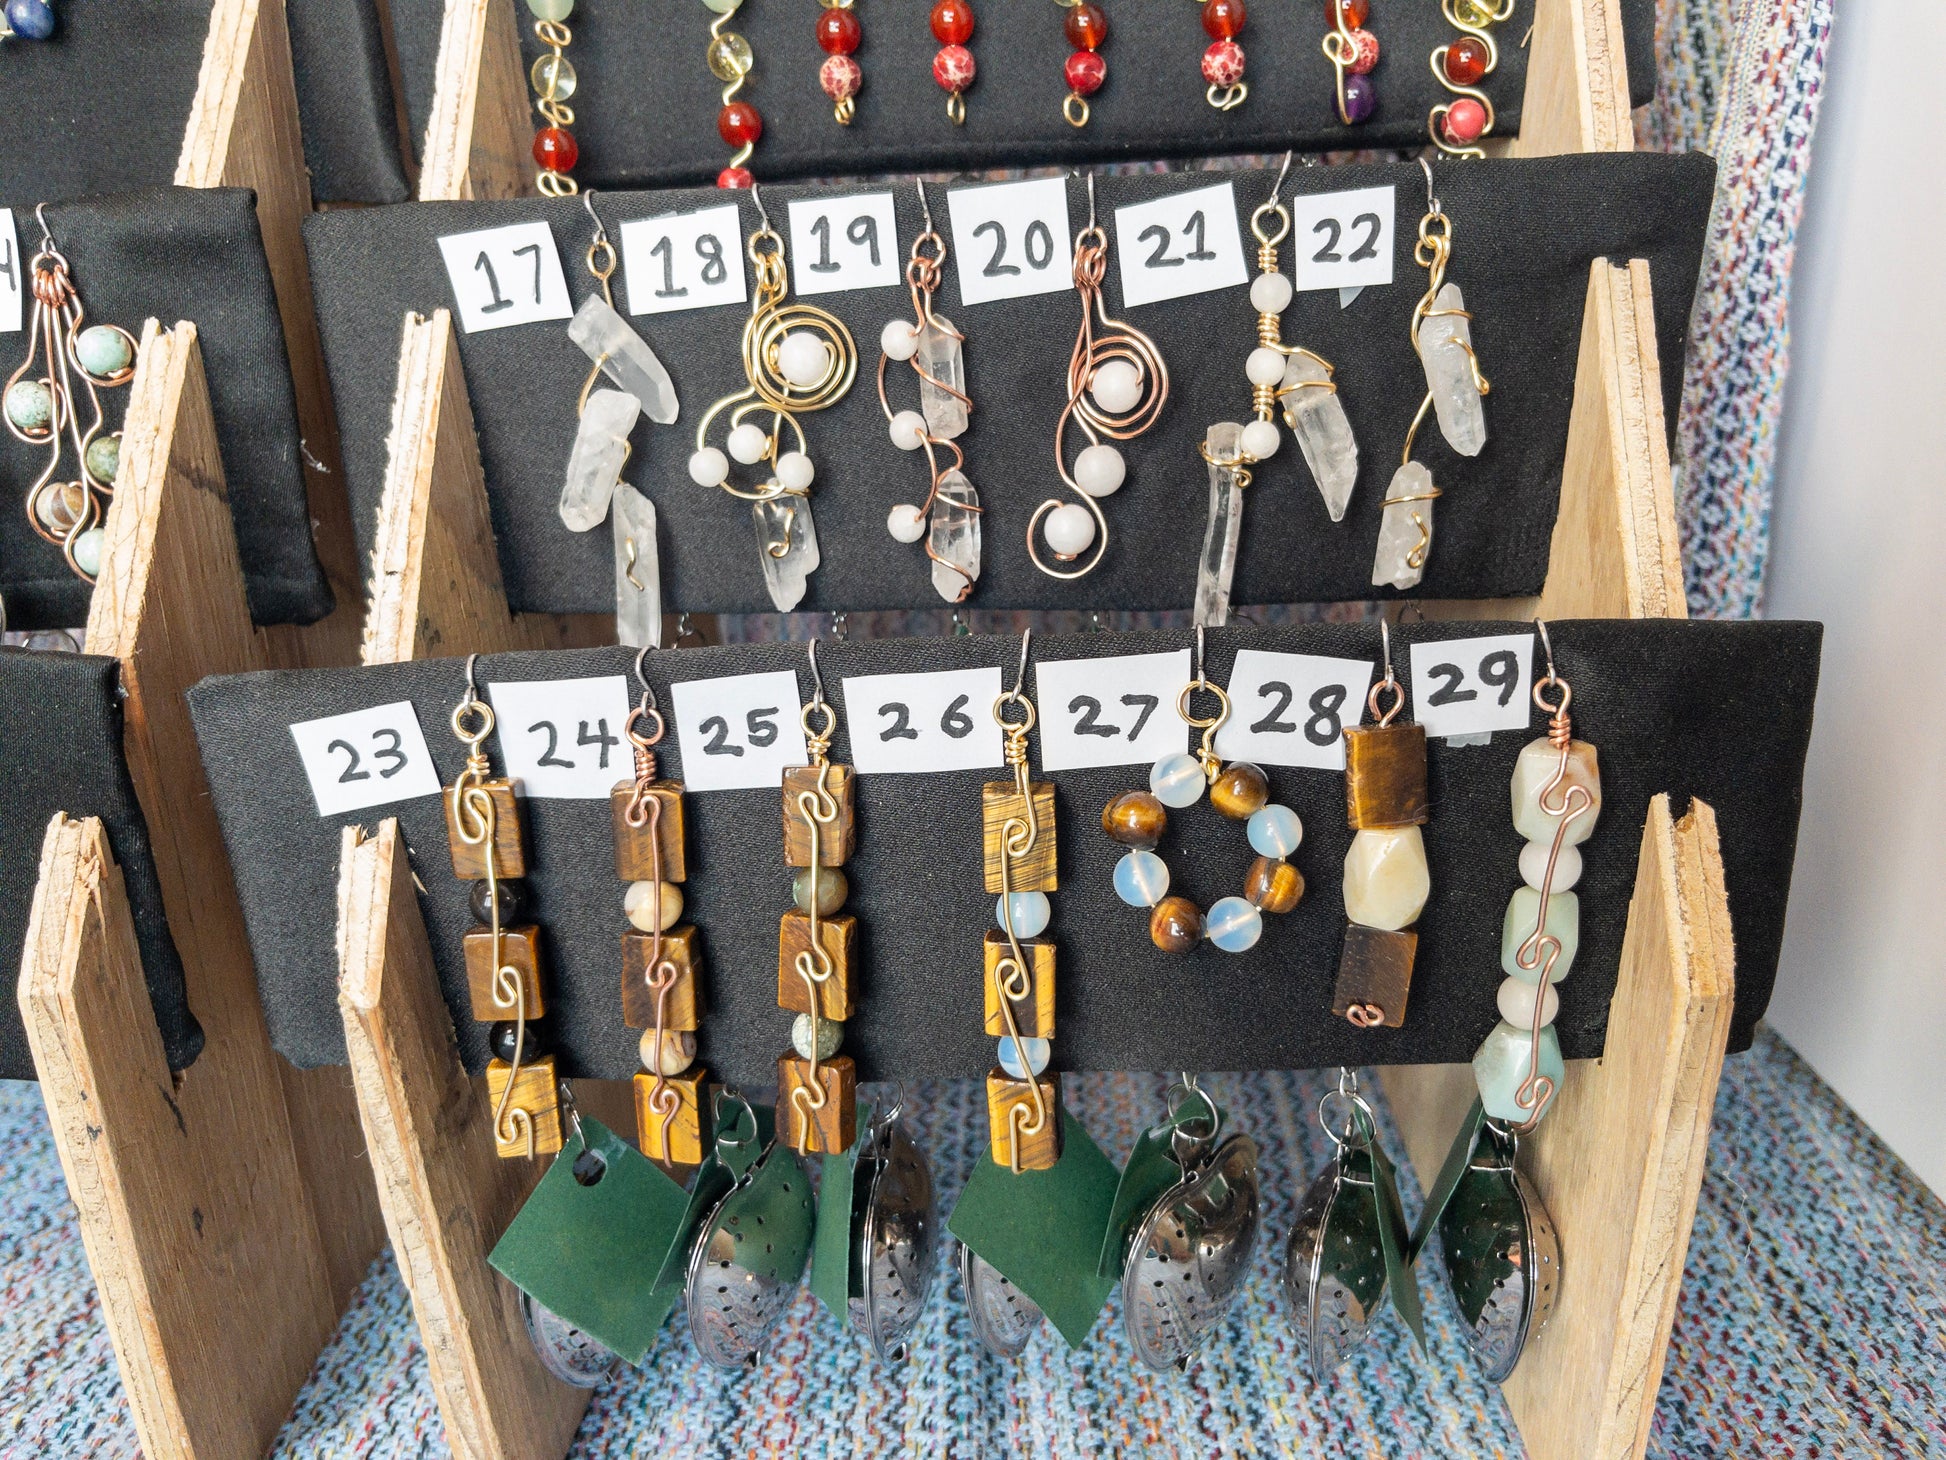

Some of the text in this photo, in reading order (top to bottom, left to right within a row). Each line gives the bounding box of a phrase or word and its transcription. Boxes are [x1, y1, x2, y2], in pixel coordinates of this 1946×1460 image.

[650, 234, 728, 298] 18
[809, 214, 881, 273] 19
[972, 219, 1054, 277] 20
[1137, 210, 1217, 268] 21
[1312, 212, 1381, 263] 22
[474, 244, 542, 314] 17
[1427, 649, 1519, 708] 29
[698, 706, 779, 757] 25
[877, 694, 974, 742] 26
[1068, 693, 1159, 742] 27
[1250, 681, 1347, 746] 28
[327, 728, 407, 783] 23
[527, 718, 619, 769] 24
